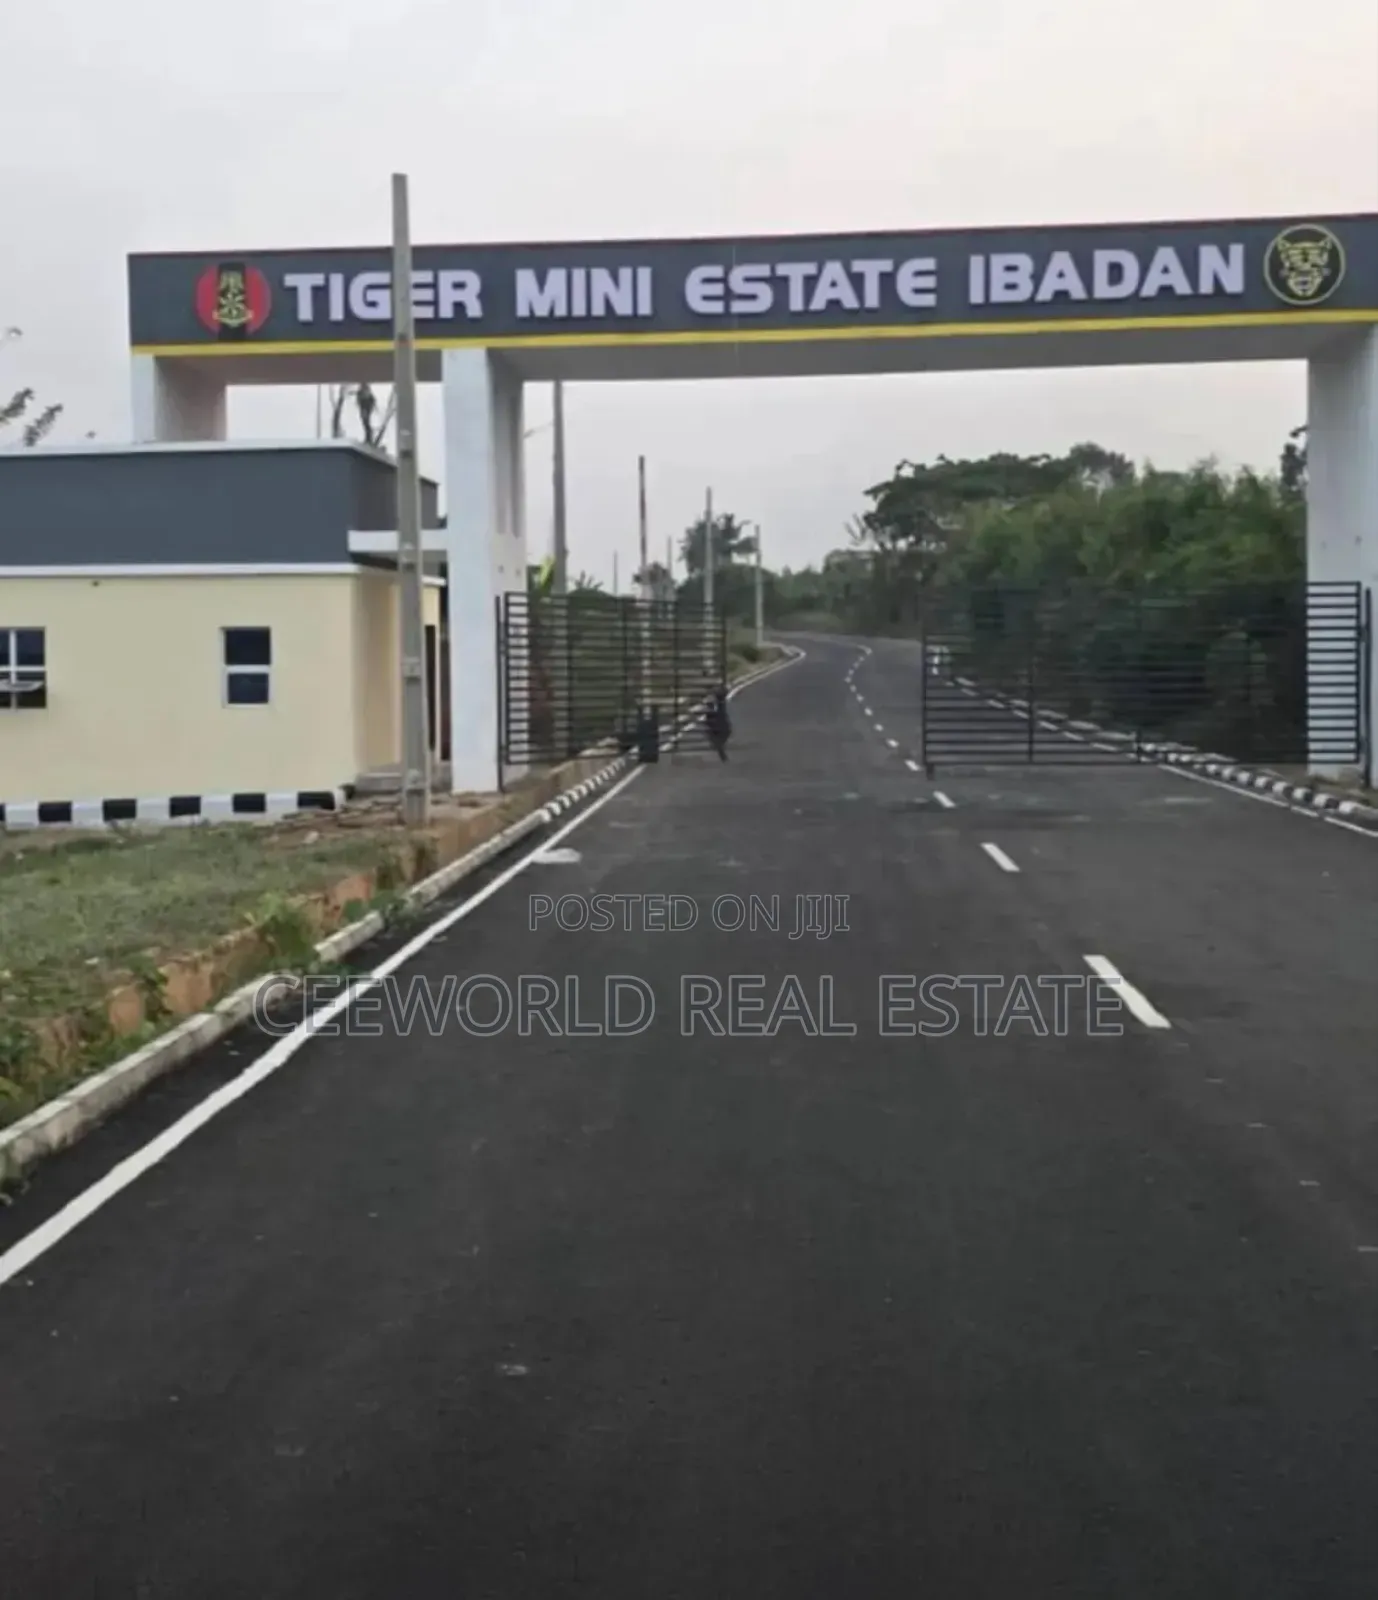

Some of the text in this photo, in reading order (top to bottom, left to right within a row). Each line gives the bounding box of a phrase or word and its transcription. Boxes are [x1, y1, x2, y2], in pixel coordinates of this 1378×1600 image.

[515, 266, 652, 319] MINI
[685, 257, 937, 314] ESTATE
[968, 244, 1245, 305] IBADAN
